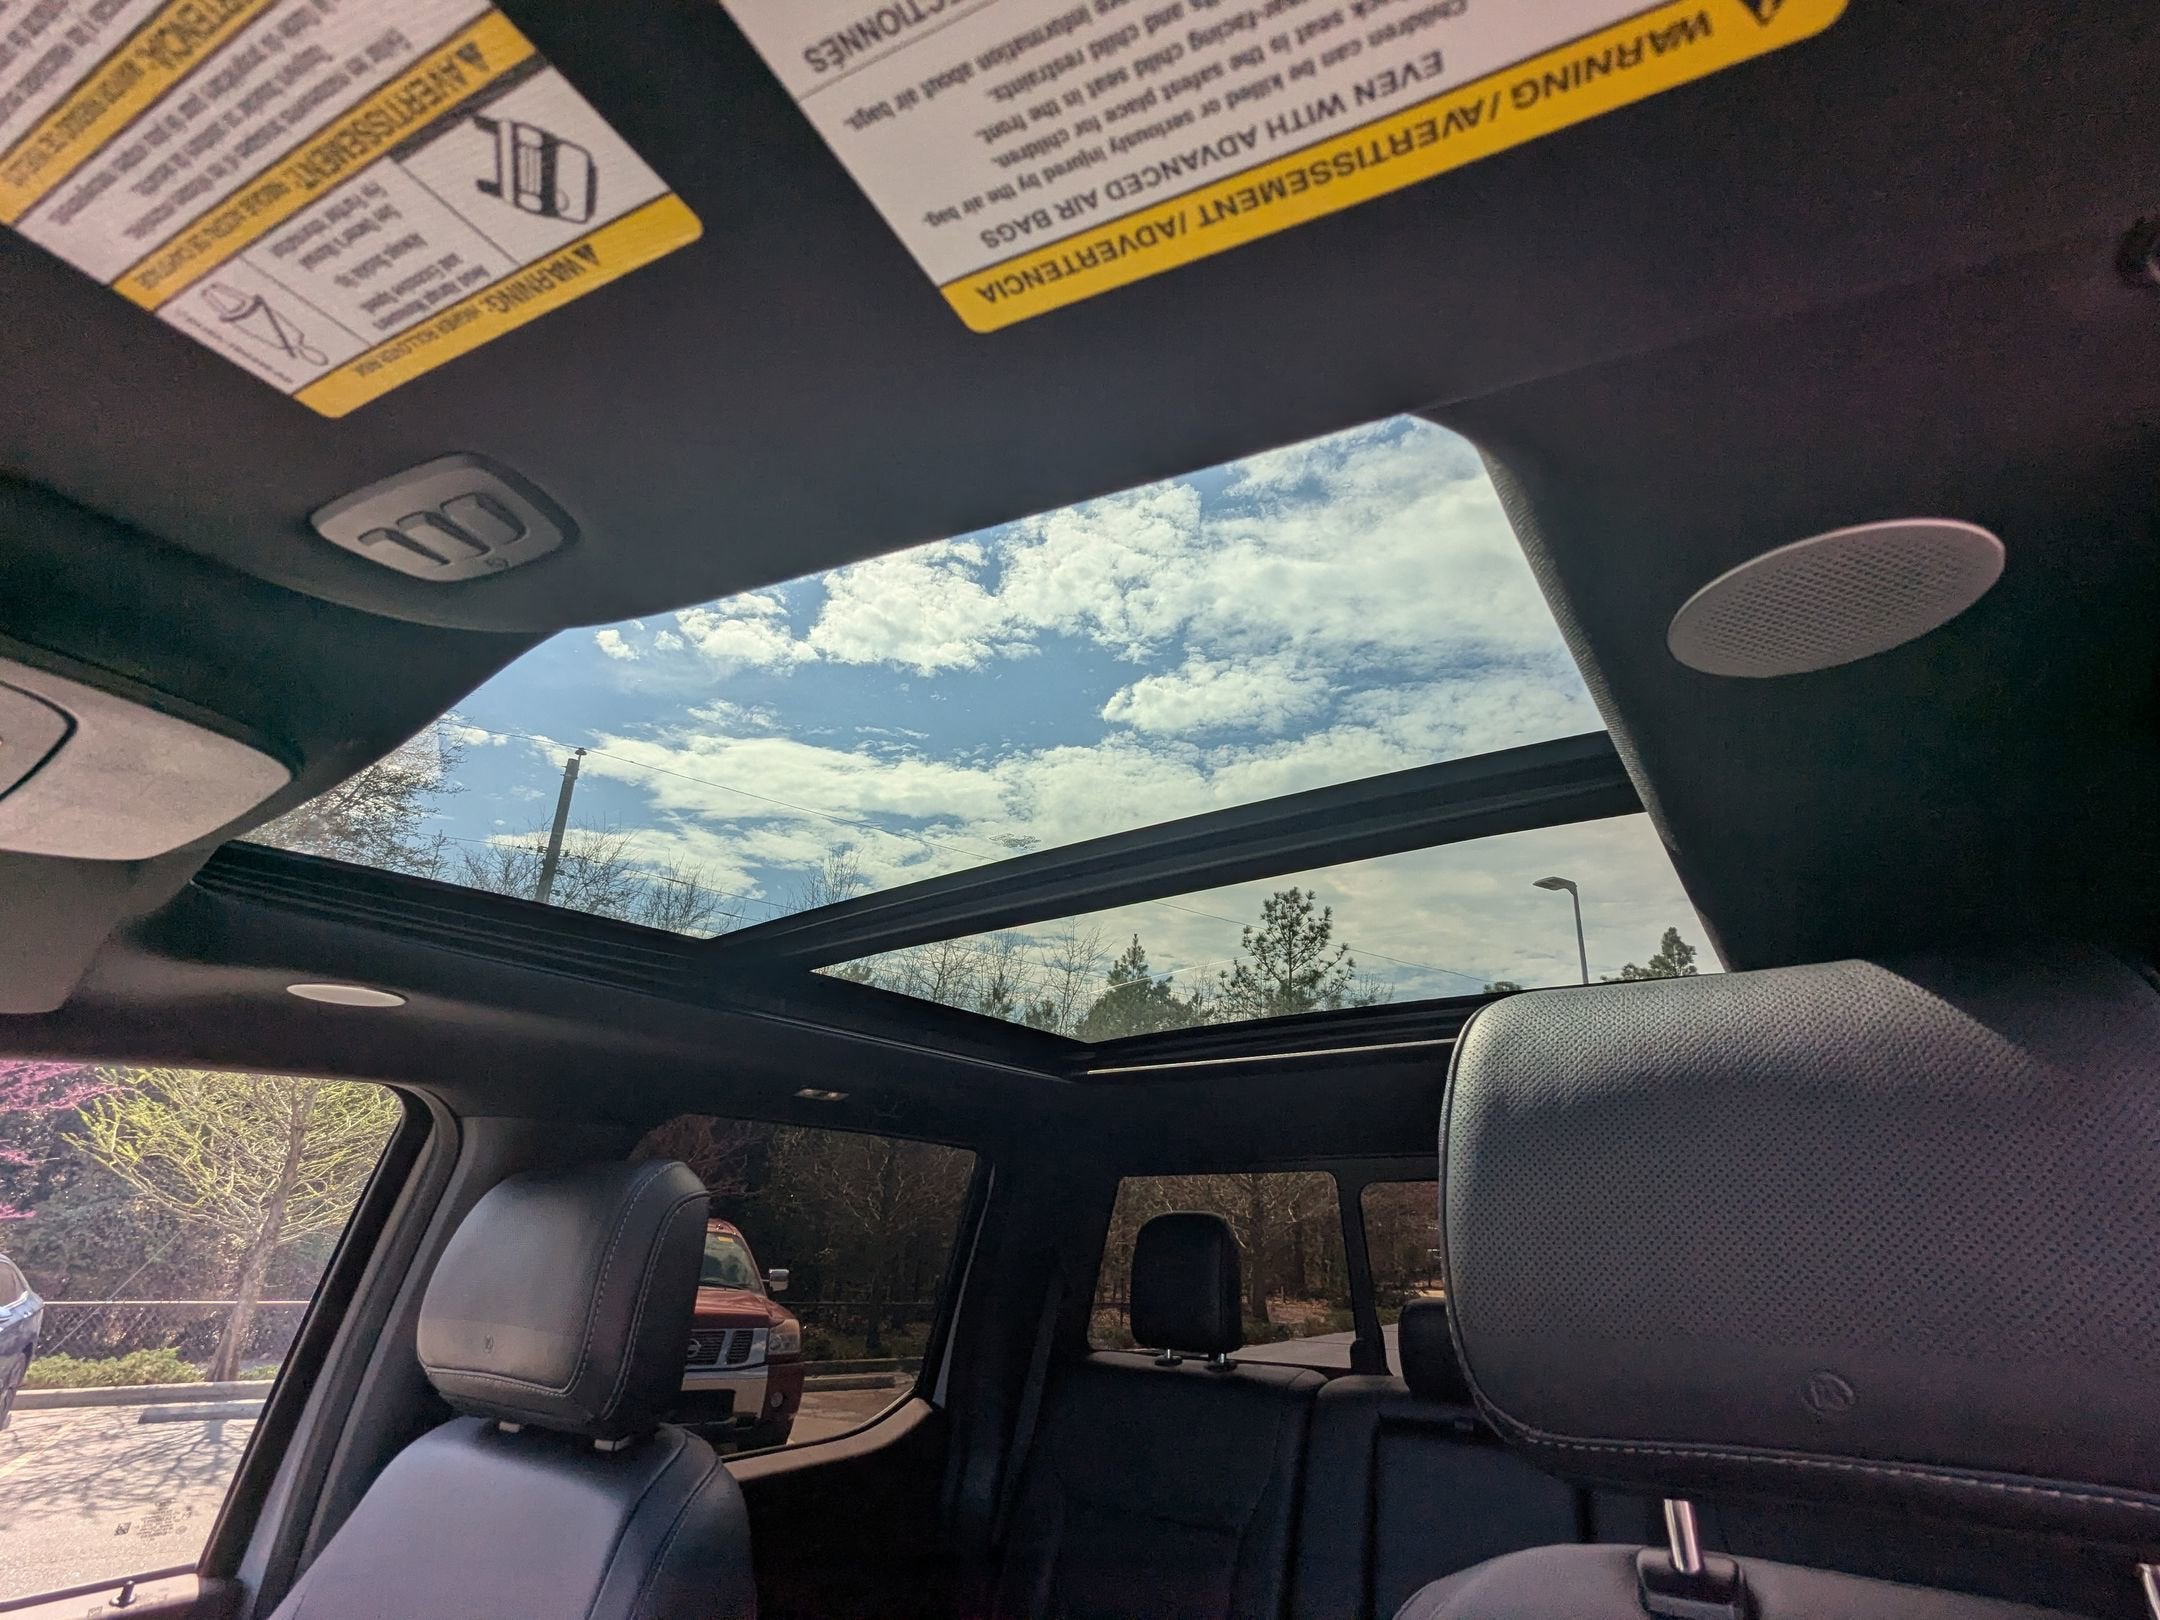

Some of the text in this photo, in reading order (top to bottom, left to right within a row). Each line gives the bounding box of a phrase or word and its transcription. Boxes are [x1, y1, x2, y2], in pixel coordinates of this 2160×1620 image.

[1229, 45, 1266, 72] the
[1160, 62, 1225, 102] safest
[1225, 73, 1284, 110] killed
[1027, 99, 1062, 122] the
[1200, 98, 1222, 119] or
[1108, 109, 1195, 154] seriously
[975, 10, 1712, 304] WARNING /AVERTISSEMENT /ADVERTENCIA
[980, 50, 1444, 249] EVEN WITH ADVANCED AIR BAGS
[986, 183, 1018, 204] the
[1016, 172, 1043, 192] by
[962, 195, 985, 214] air
